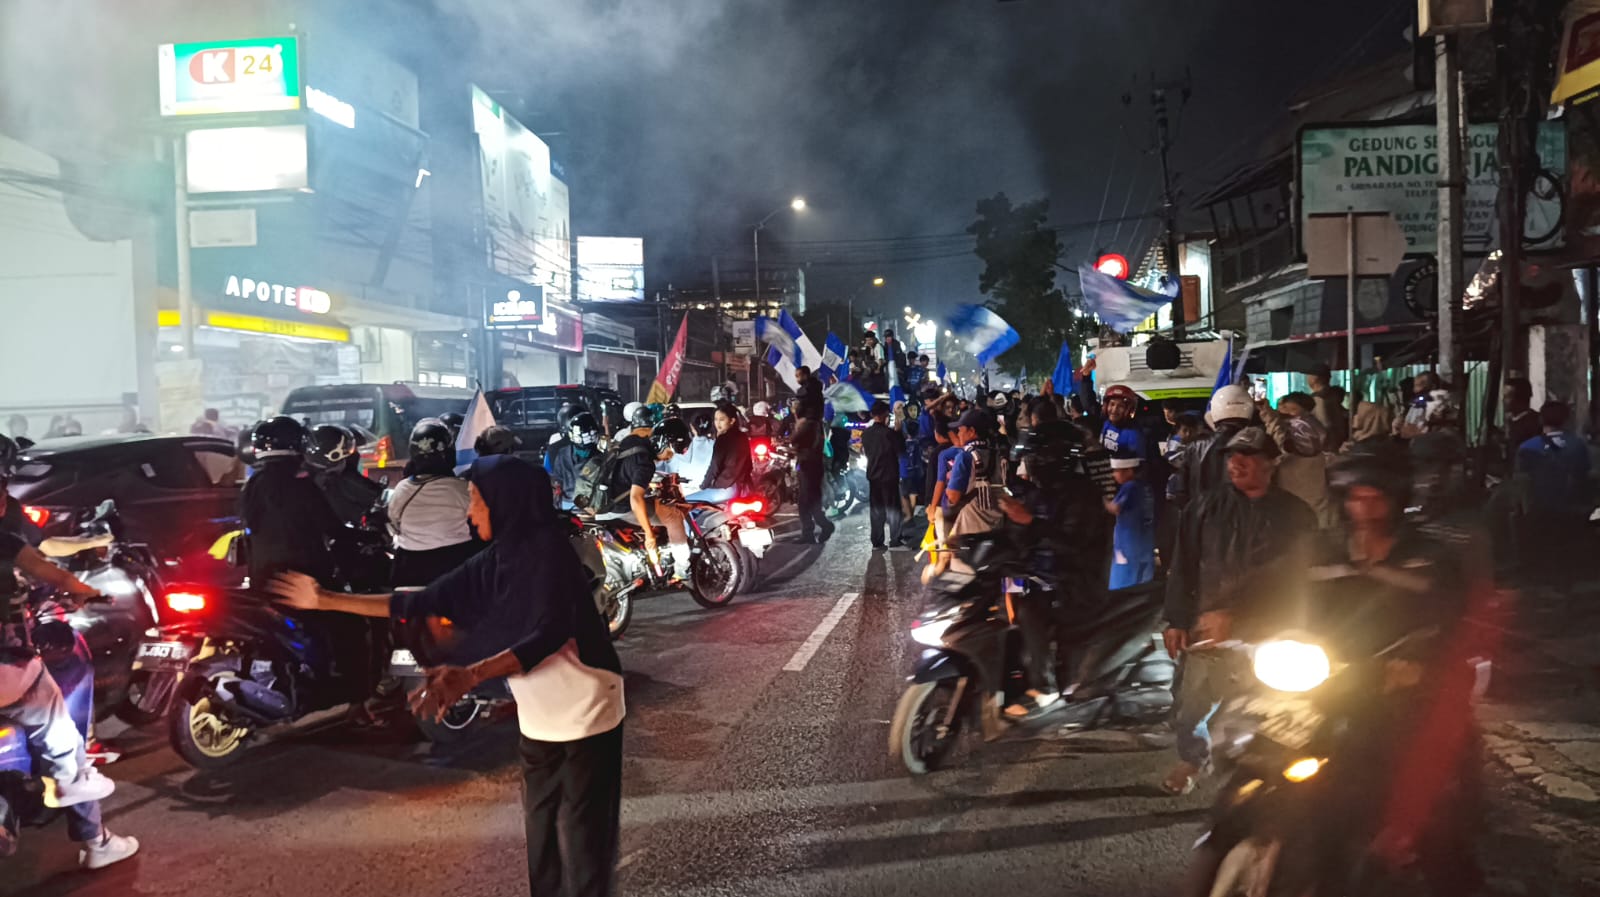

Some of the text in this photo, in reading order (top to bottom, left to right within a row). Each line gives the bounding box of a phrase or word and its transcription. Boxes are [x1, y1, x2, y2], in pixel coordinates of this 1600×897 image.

[202, 51, 273, 83] K 24
[1349, 136, 1417, 152] GEDUNG
